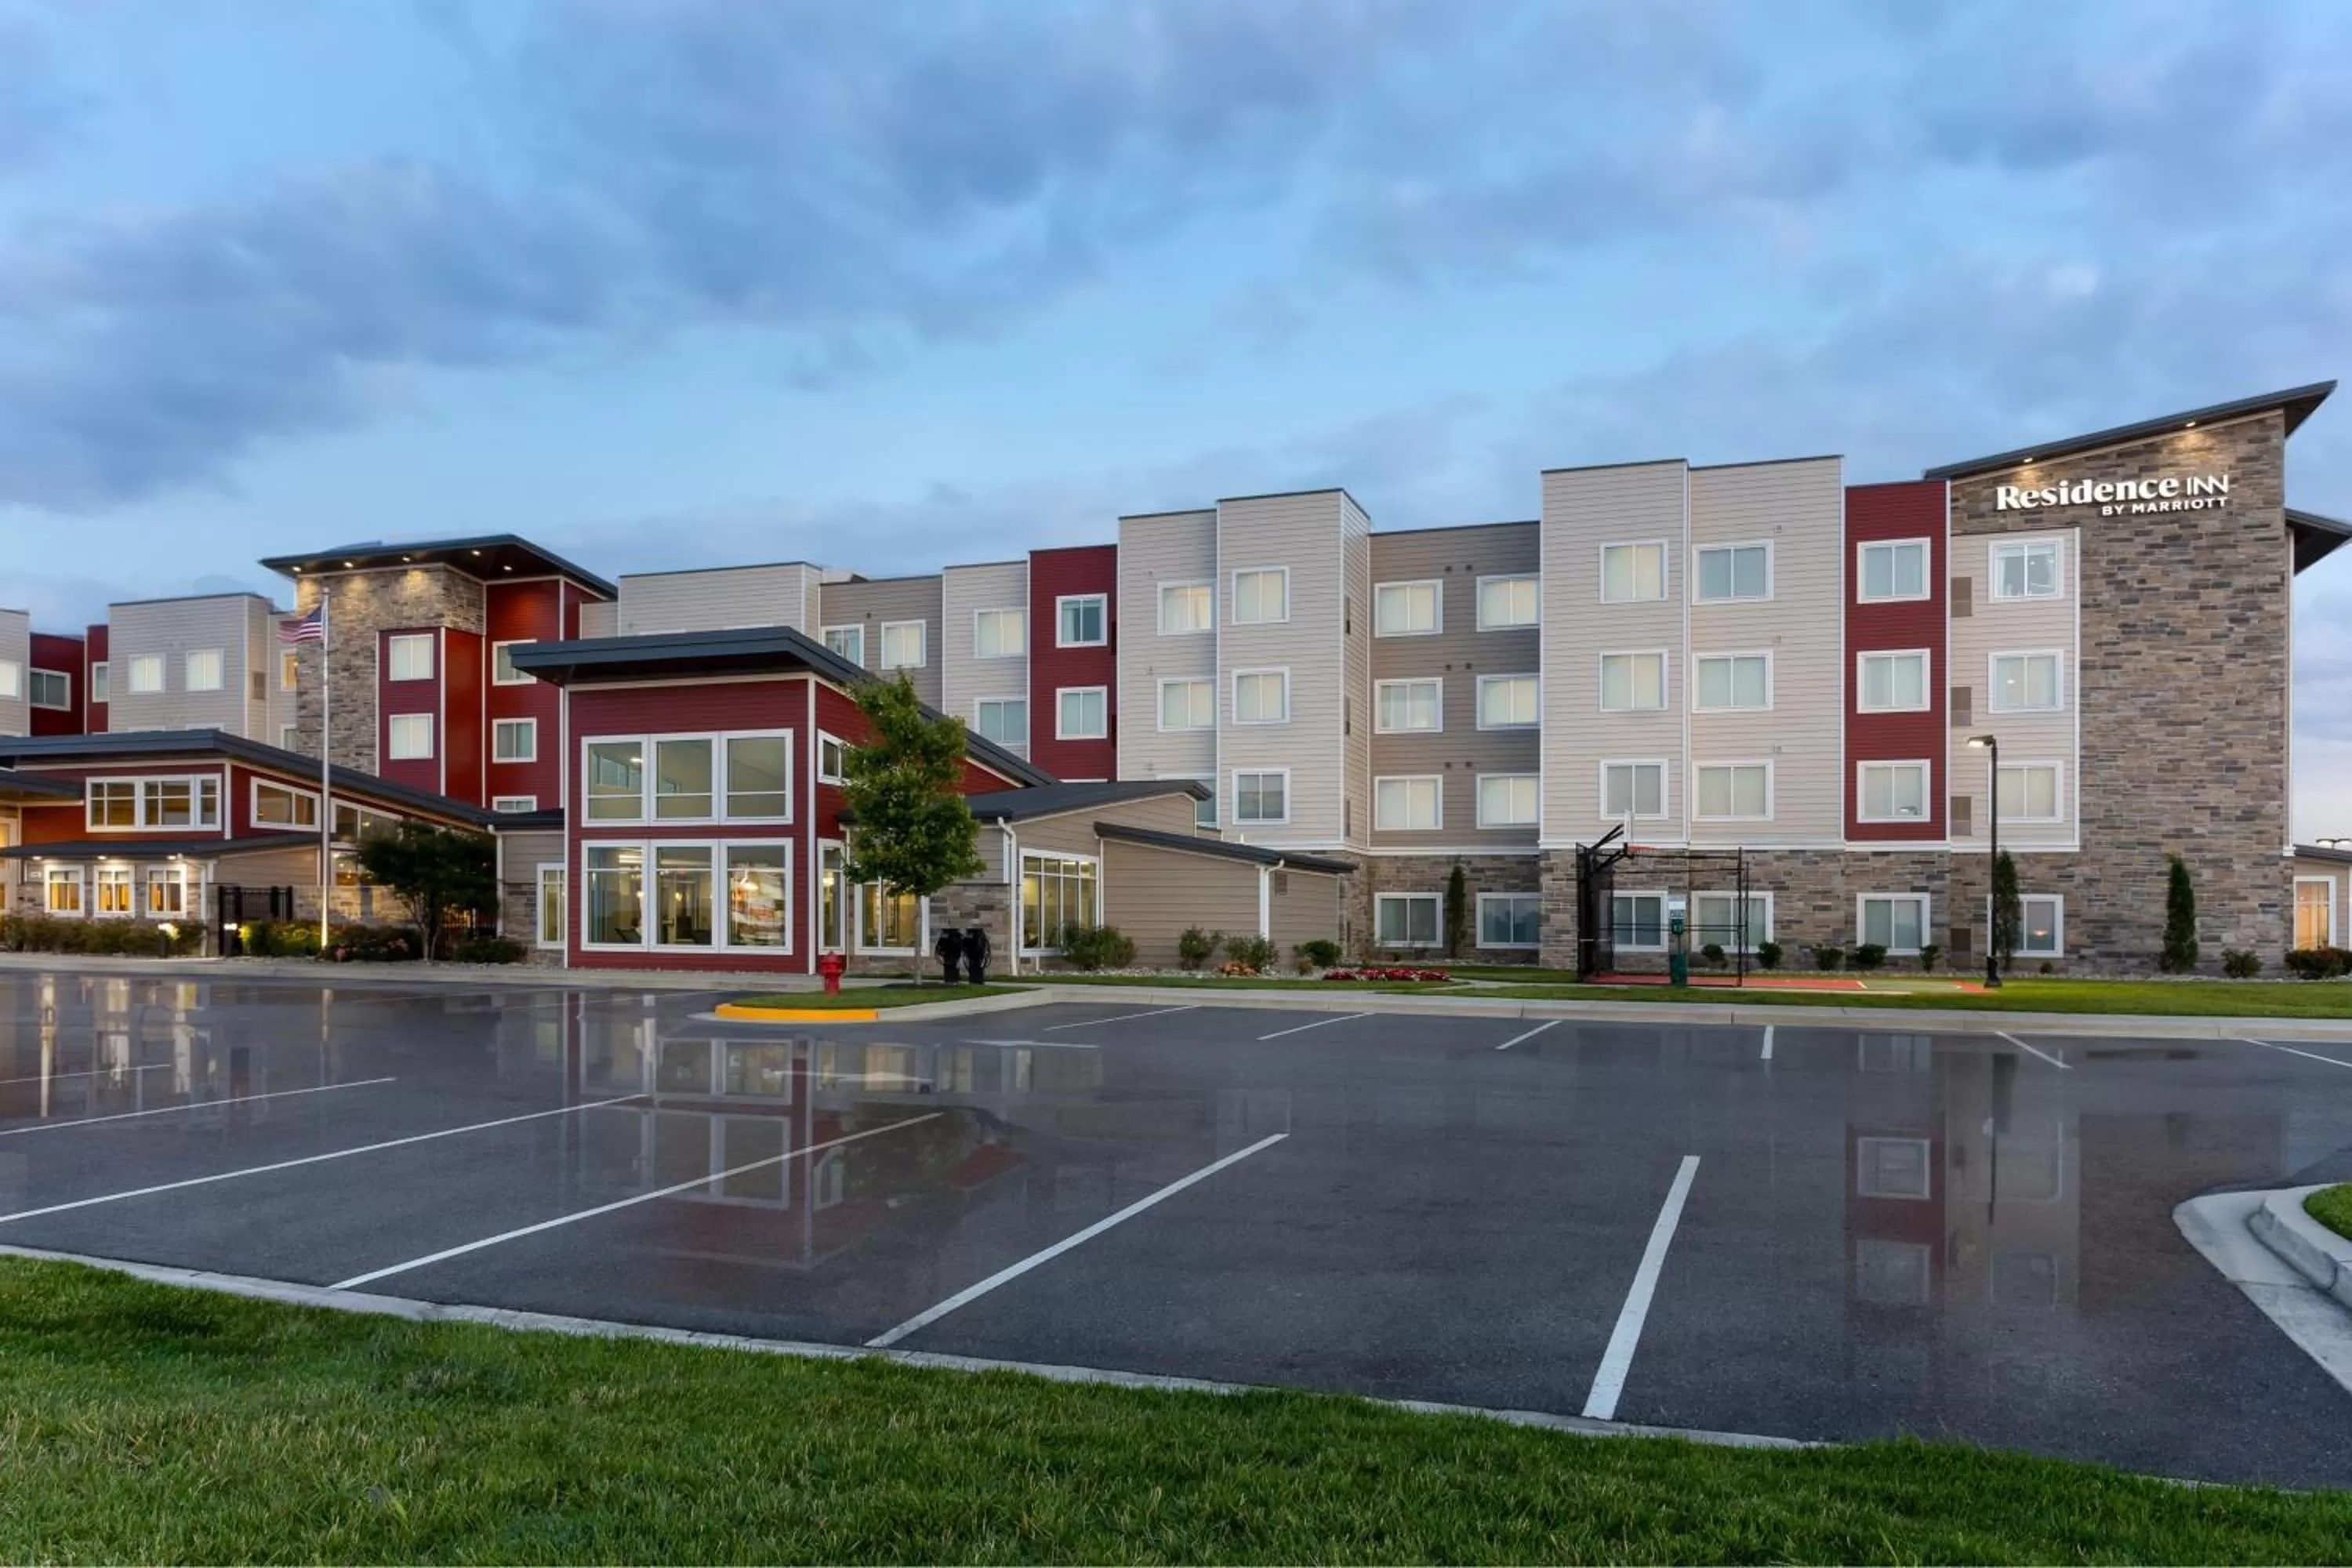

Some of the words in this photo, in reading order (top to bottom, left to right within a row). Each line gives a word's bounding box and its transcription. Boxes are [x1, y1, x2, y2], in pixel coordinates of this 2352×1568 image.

[1996, 477, 2179, 510] Residence
[2186, 474, 2230, 495] INN
[2102, 505, 2123, 517] BY
[2131, 496, 2228, 514] MARRIOTT
